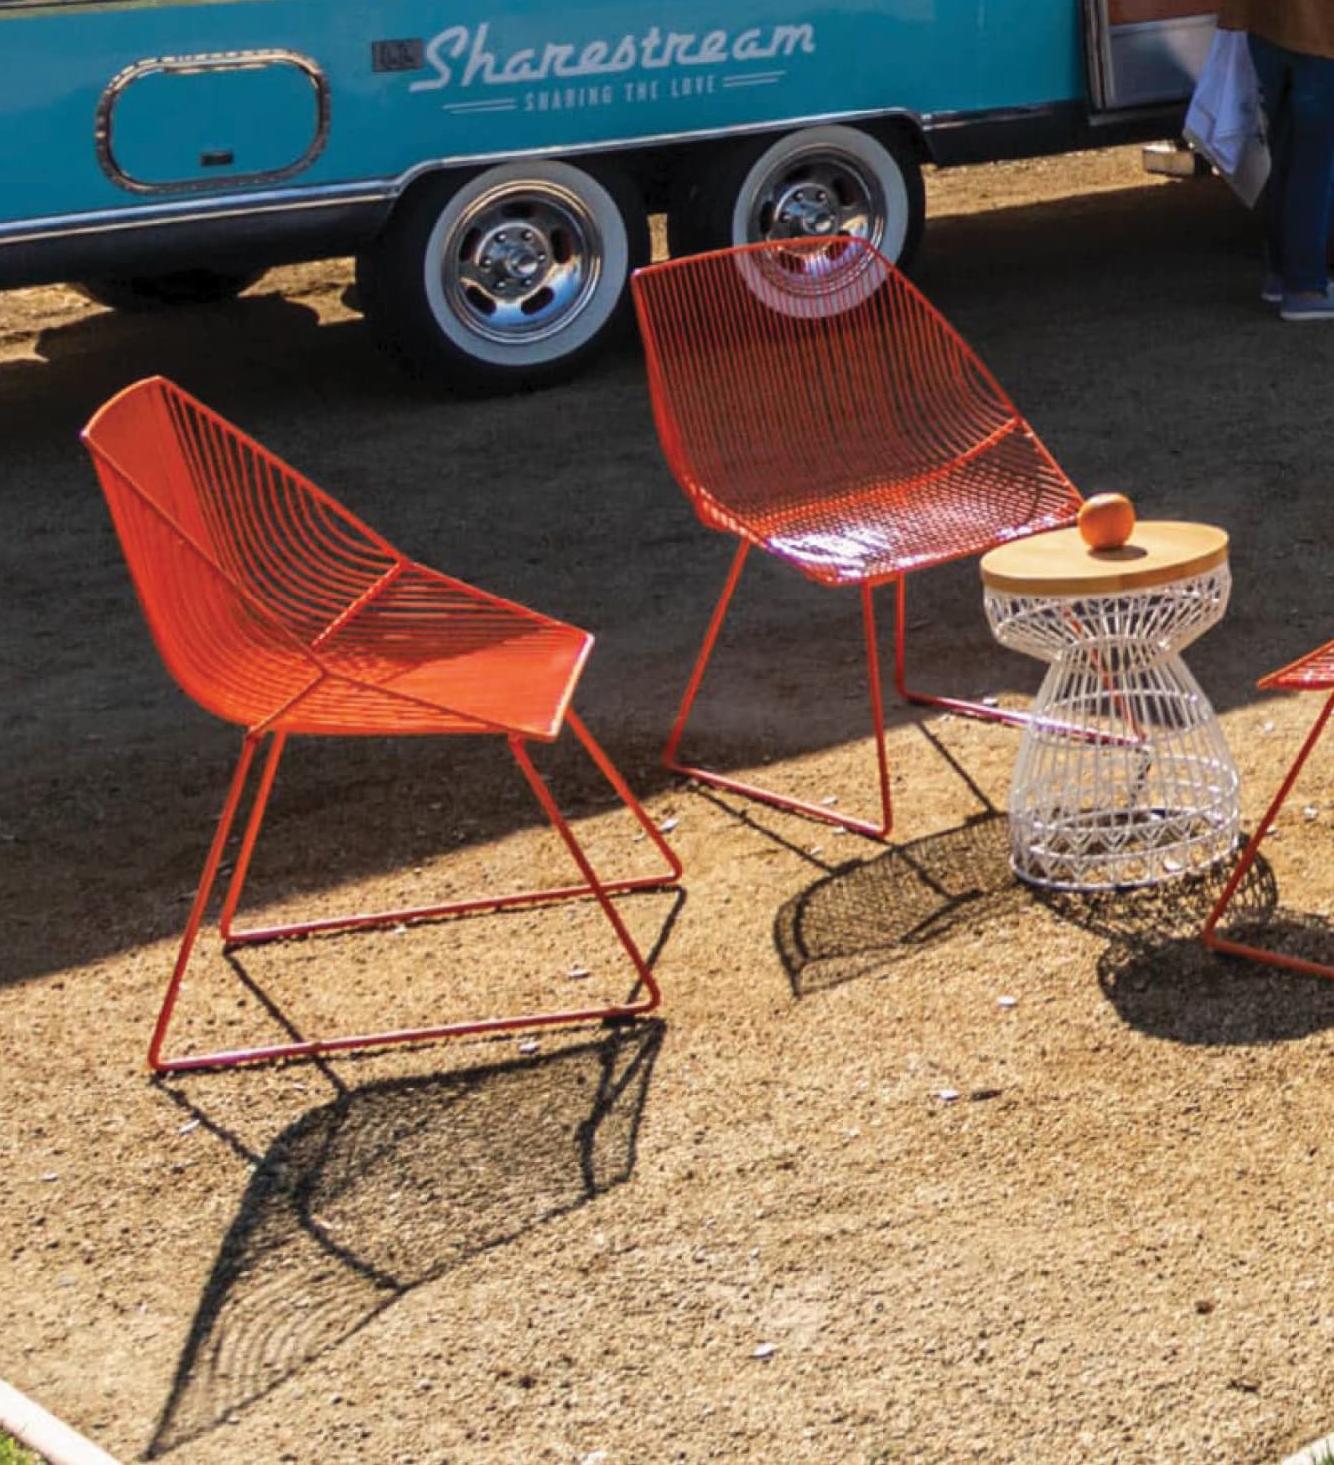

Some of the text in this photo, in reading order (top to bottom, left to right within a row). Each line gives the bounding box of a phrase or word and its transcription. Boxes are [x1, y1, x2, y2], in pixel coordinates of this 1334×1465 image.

[409, 21, 815, 92] Sharestream
[525, 75, 716, 112] SHARING THE LOVE
